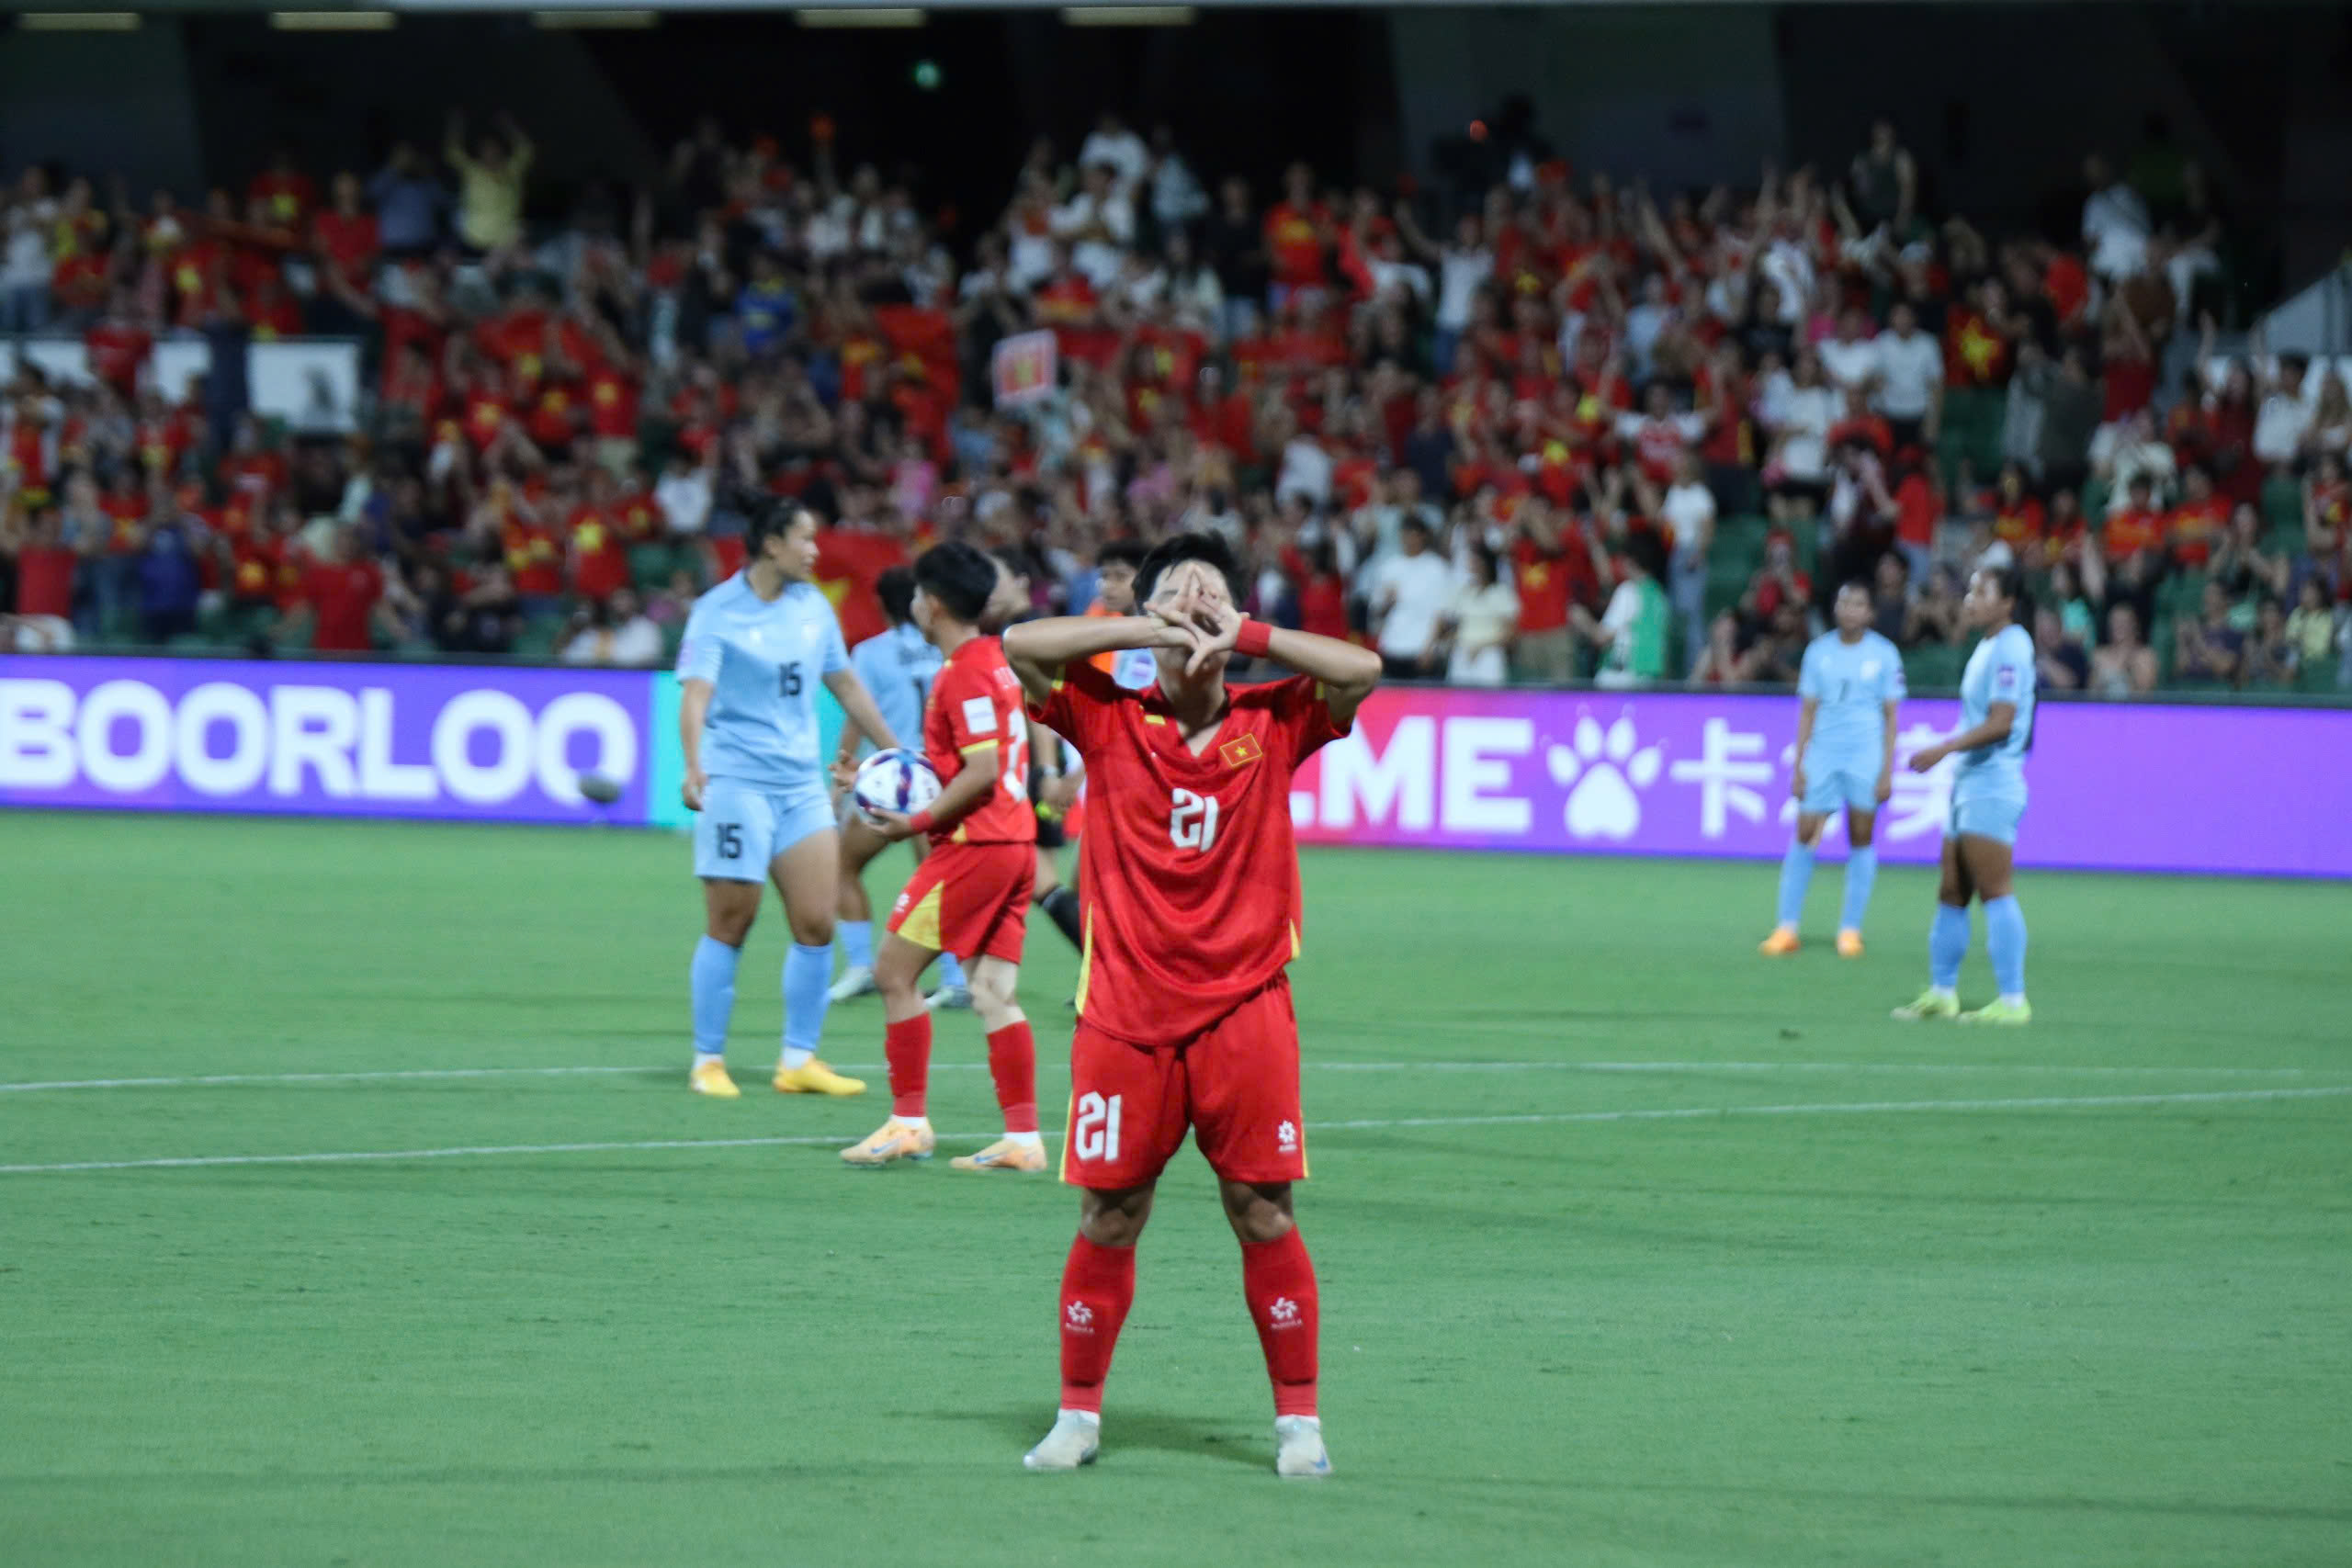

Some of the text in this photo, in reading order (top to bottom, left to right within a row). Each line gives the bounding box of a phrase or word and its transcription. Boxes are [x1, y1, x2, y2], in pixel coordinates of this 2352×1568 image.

[778, 660, 802, 697] 15
[1288, 715, 1535, 833] ME
[715, 823, 742, 859] 15
[1170, 787, 1220, 852] 21
[1075, 1090, 1122, 1161] 21
